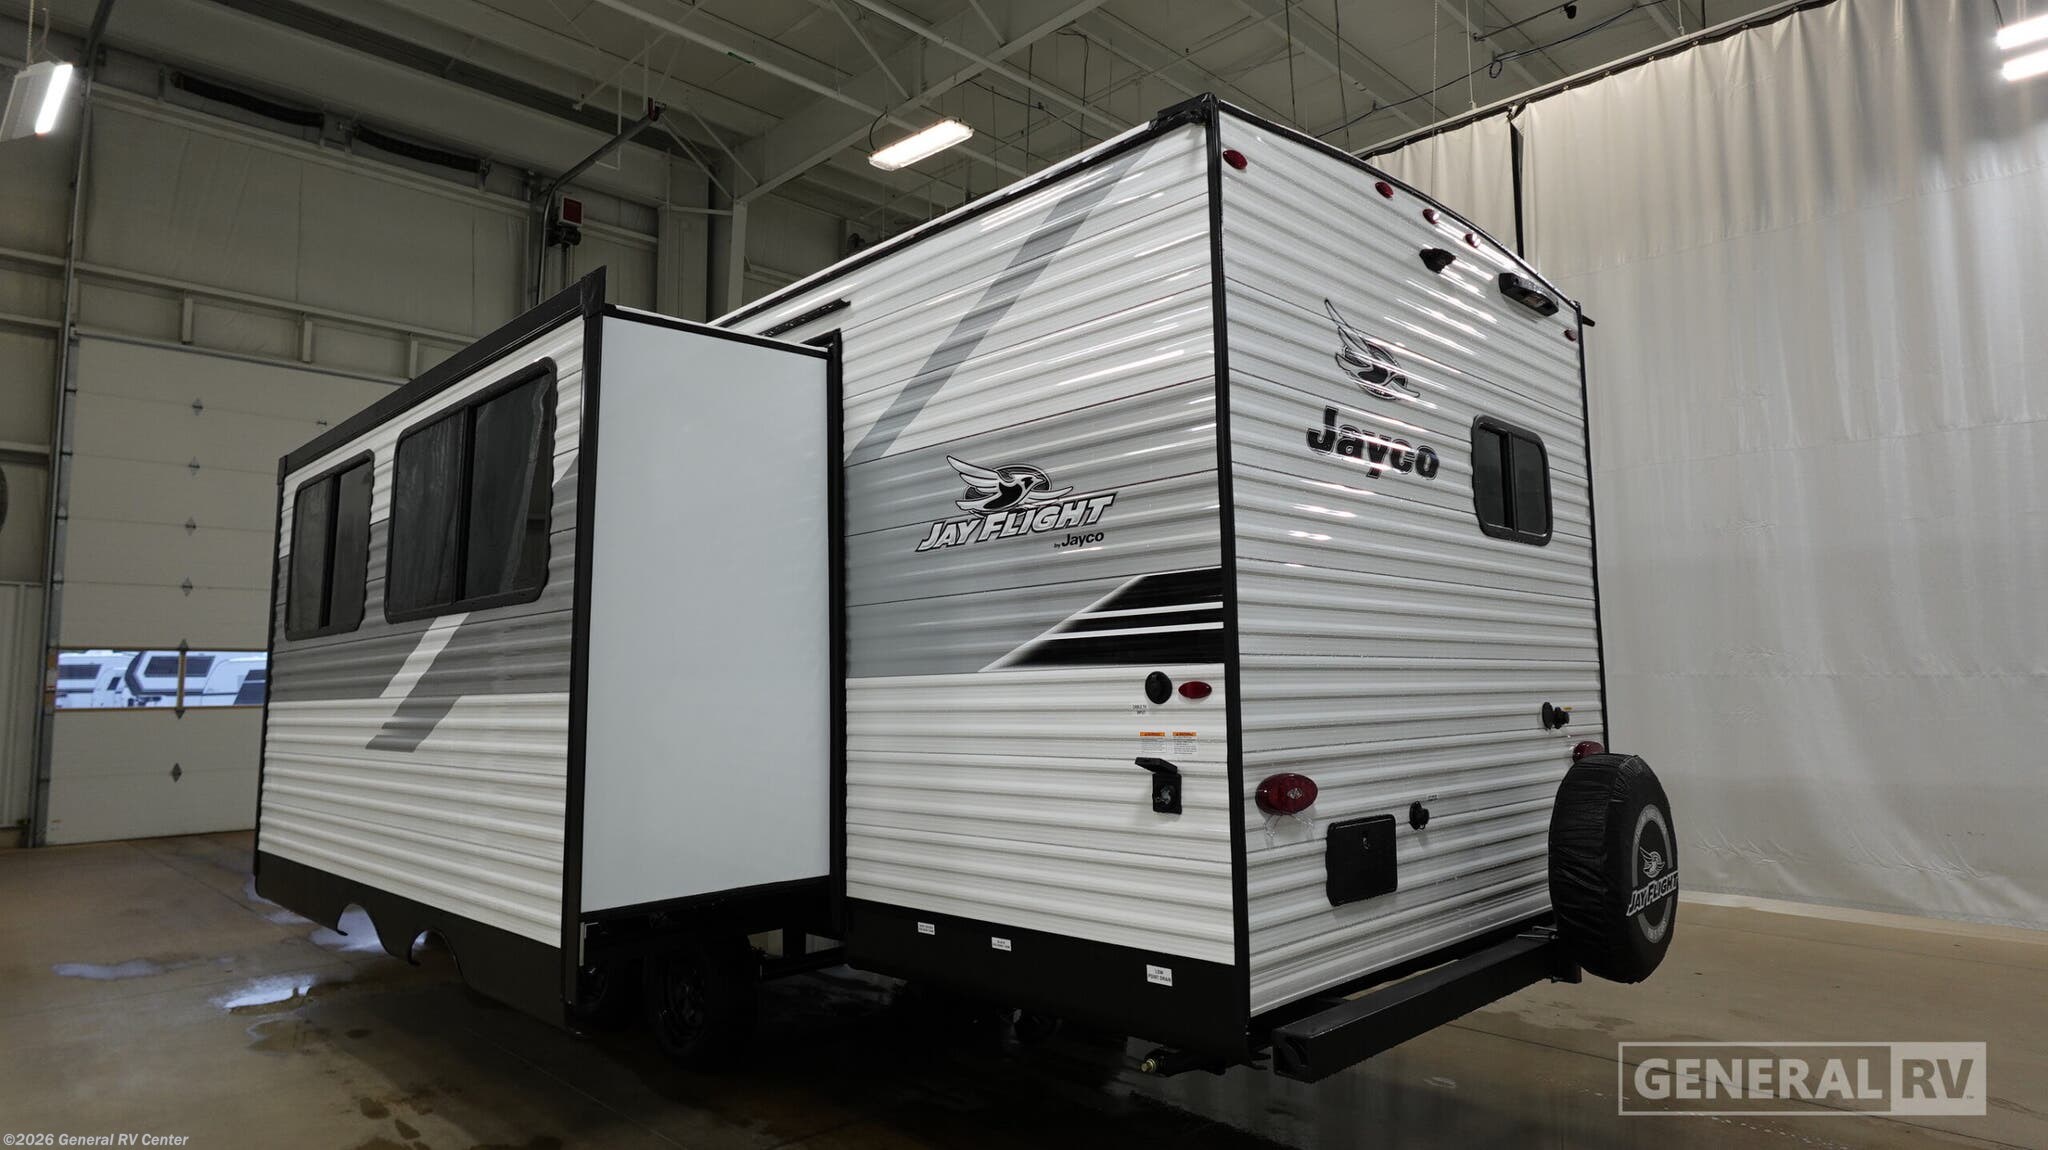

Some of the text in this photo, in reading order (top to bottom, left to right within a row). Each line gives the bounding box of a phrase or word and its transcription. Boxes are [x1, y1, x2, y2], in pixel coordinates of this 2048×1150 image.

[1305, 406, 1440, 480] Jayco
[915, 492, 1118, 552] JAY FLIGHT
[1061, 532, 1105, 548] Jayco
[1626, 870, 1679, 917] JAY FLIGHT
